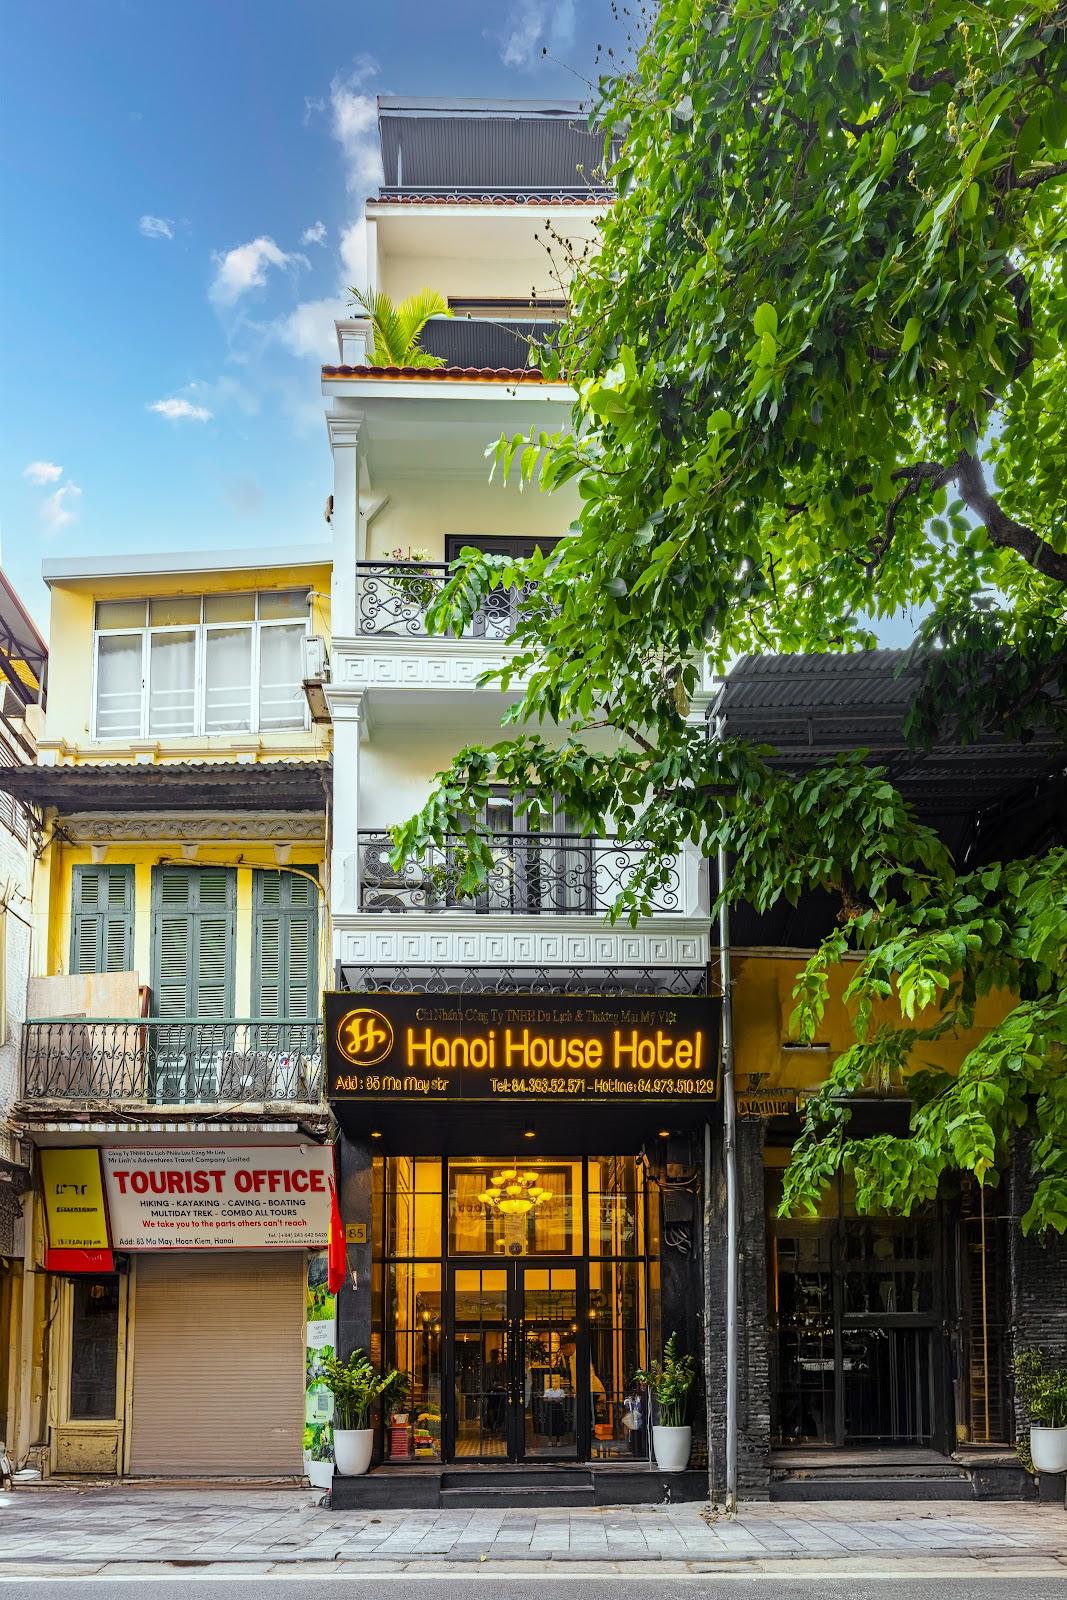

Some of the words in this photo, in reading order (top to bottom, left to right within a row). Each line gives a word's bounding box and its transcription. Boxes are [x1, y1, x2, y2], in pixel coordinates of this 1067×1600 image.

[491, 1008, 504, 1024] Ty
[506, 1009, 536, 1021] TNHH
[575, 1009, 584, 1022] &
[406, 1028, 496, 1069] Hanoi
[505, 1029, 603, 1068] House
[613, 1030, 703, 1070] Hotel
[366, 1075, 380, 1090] 85
[382, 1075, 402, 1091] Ma
[404, 1076, 430, 1094] May
[430, 1076, 449, 1091] str
[196, 1156, 226, 1164] Company
[113, 1170, 226, 1194] TOURIST
[234, 1170, 326, 1193] OFFICE
[268, 1199, 306, 1207] BOATING
[221, 1209, 253, 1217] COMBO
[142, 1220, 156, 1228] We
[157, 1220, 174, 1228] take
[176, 1221, 190, 1230] you
[191, 1220, 199, 1228] to
[201, 1220, 214, 1228] the
[216, 1220, 236, 1229] parts
[237, 1219, 261, 1227] others
[262, 1219, 284, 1227] can't
[348, 1229, 364, 1239] 85
[159, 1238, 175, 1247] May,
[194, 1237, 213, 1246] Kiem,
